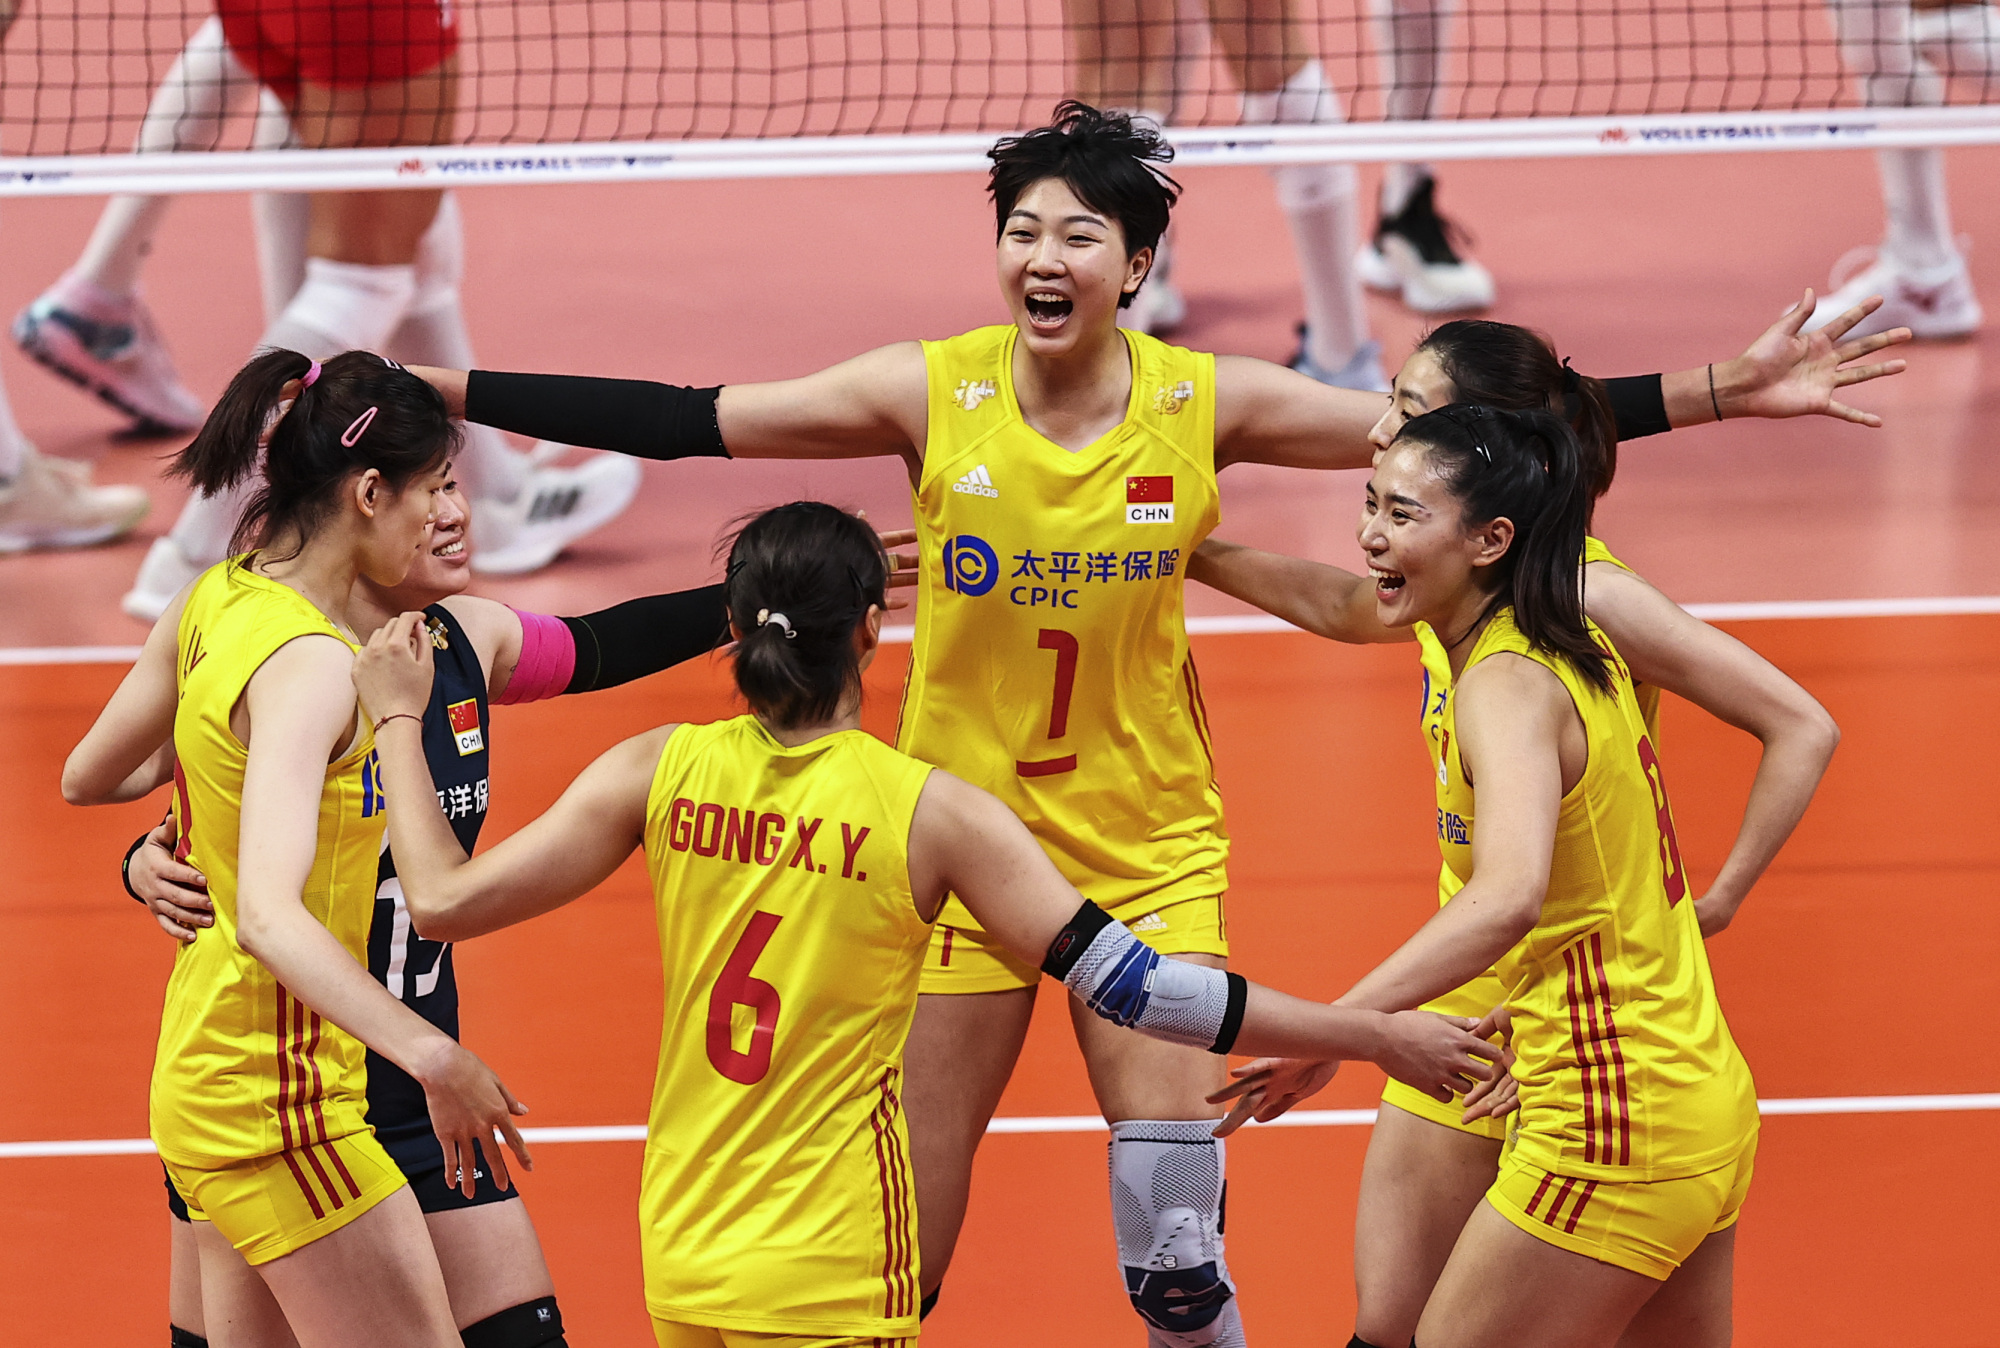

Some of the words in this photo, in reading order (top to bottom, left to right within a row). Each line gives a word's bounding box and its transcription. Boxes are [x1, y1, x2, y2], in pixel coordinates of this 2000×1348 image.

[952, 481, 999, 499] adidas
[1131, 508, 1169, 521] CHN
[1011, 549, 1180, 583] 太平洋保险
[1010, 586, 1079, 609] CPIC
[461, 733, 481, 750] CHN
[669, 797, 786, 866] GONG
[1133, 920, 1168, 932] adidas
[706, 909, 784, 1086] 6
